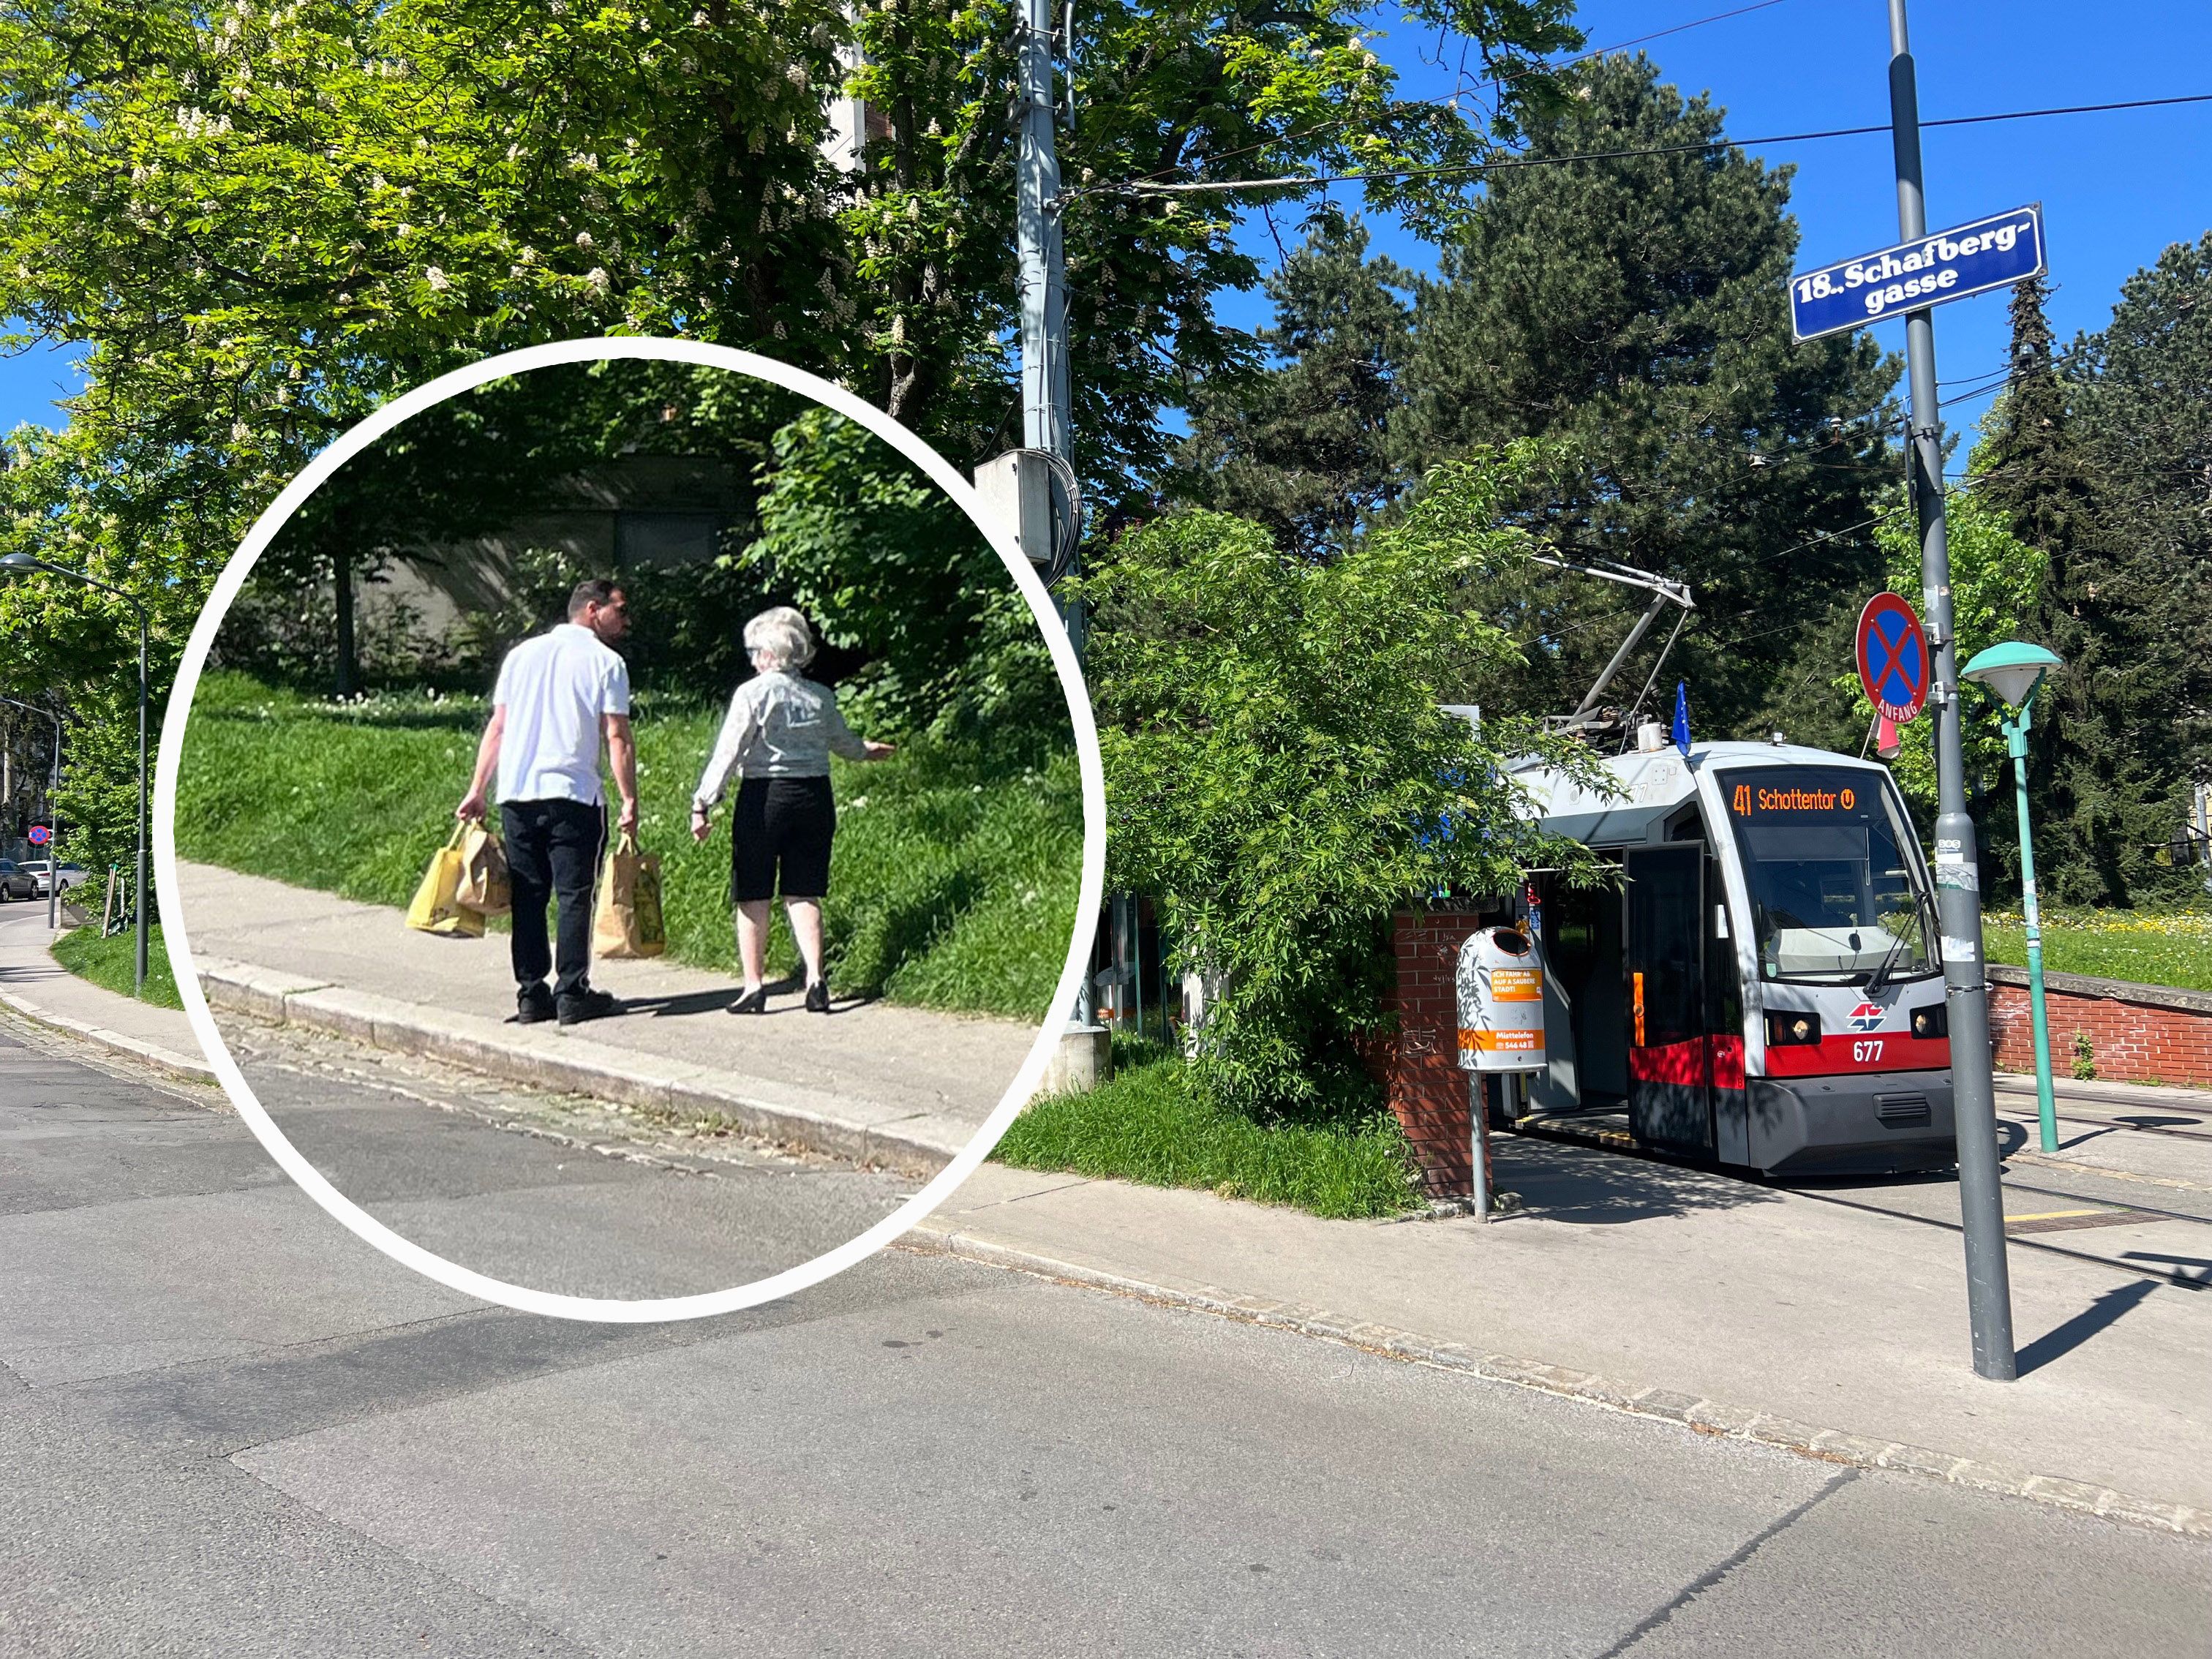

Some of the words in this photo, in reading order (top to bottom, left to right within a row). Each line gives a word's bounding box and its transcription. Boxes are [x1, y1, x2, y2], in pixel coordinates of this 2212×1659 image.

[1844, 222, 2031, 288] Schafberg-
[1865, 269, 1959, 314] gasse
[1878, 699, 1917, 722] ANFANG
[1733, 784, 1752, 816] 41
[1758, 789, 1837, 810] Schottentor
[1854, 1040, 1884, 1061] 677
